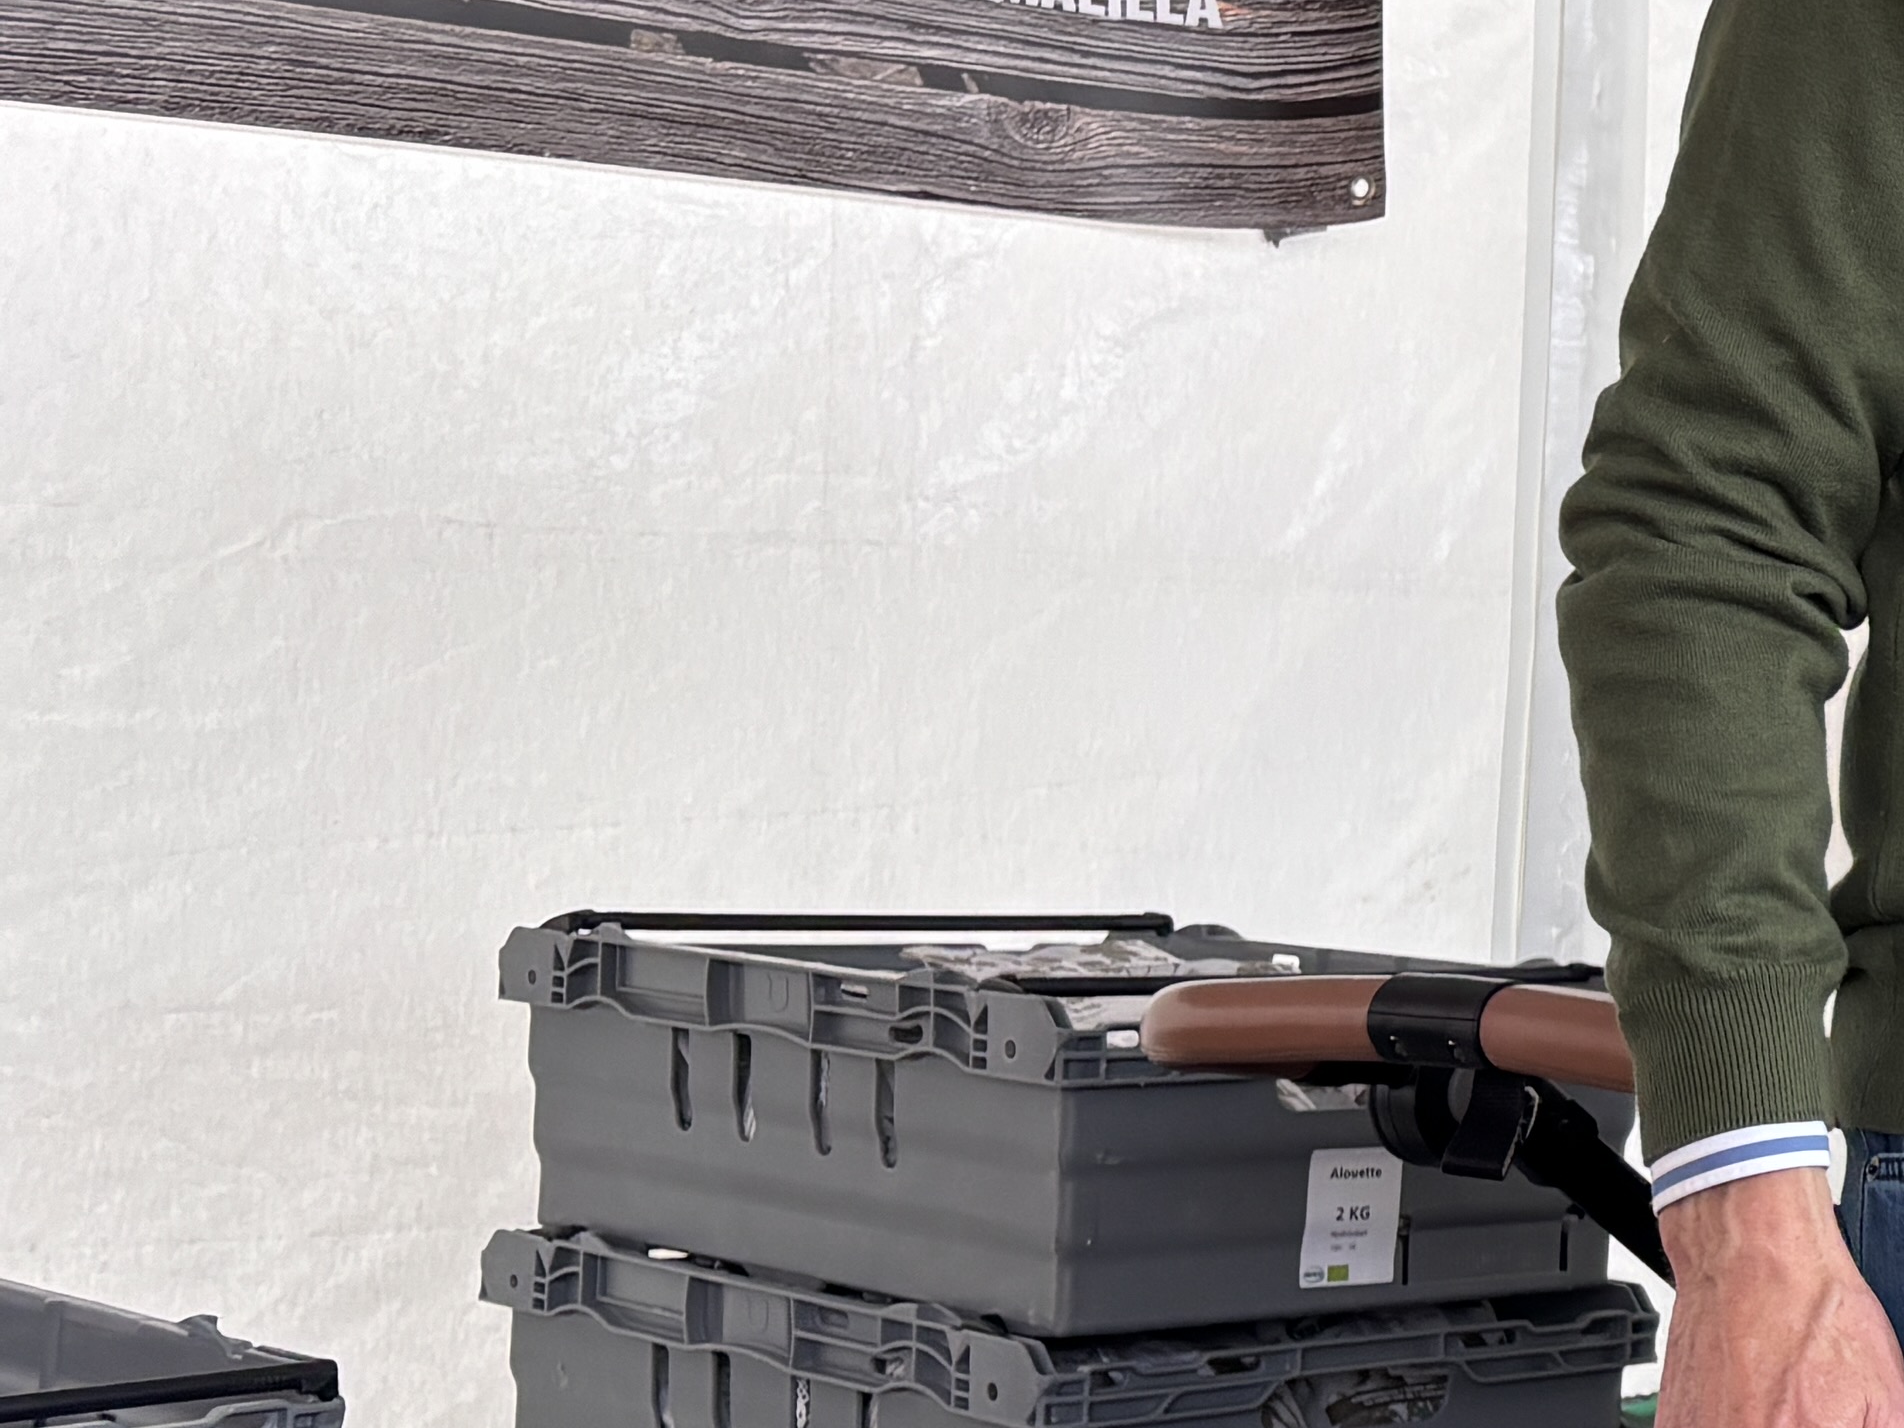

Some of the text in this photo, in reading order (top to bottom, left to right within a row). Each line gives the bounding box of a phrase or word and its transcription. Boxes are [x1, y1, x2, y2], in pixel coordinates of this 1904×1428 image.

[1330, 1165, 1382, 1180] Alouette
[1336, 1205, 1370, 1221] 2 KG
